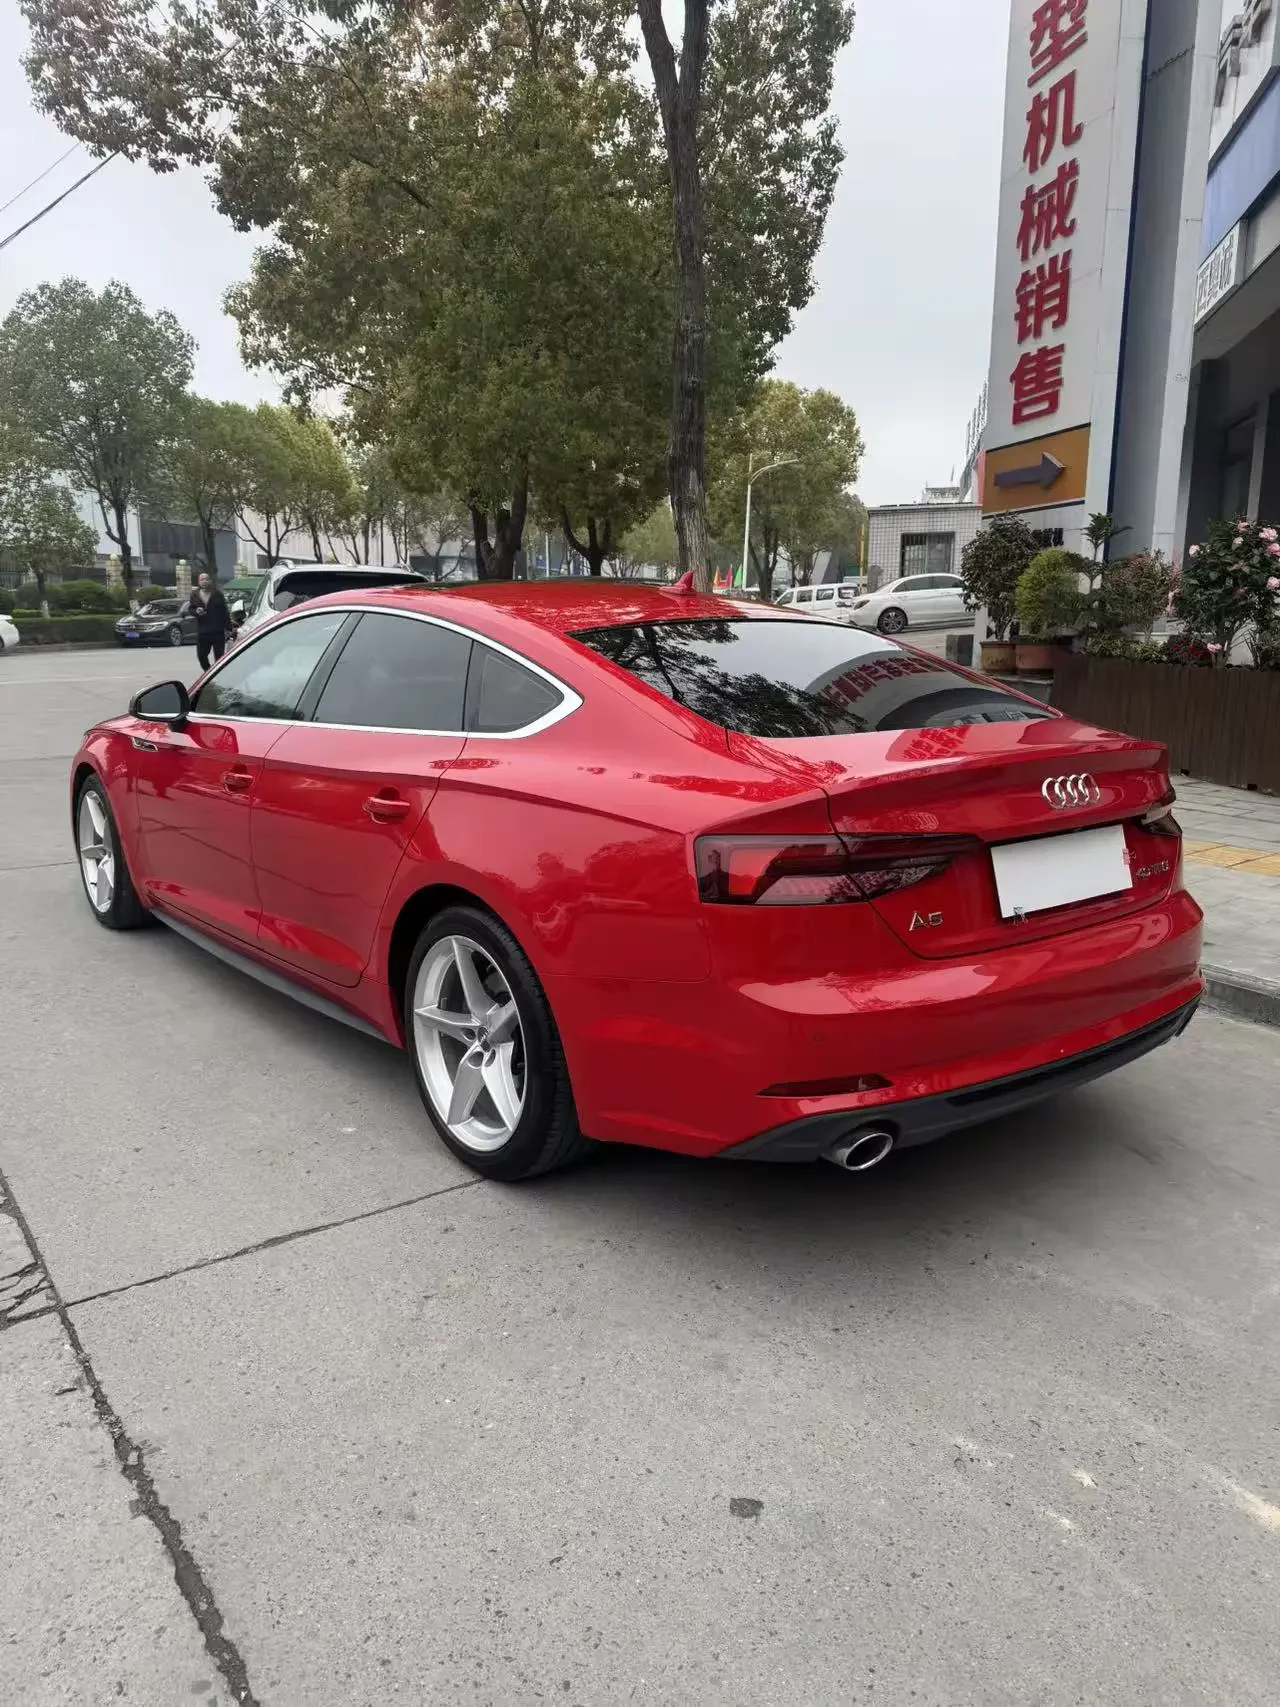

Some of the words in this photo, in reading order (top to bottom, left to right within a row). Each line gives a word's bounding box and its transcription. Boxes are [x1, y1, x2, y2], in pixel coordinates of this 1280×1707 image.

[1009, 0, 1088, 426] 型机械销售
[909, 911, 943, 931] A5
